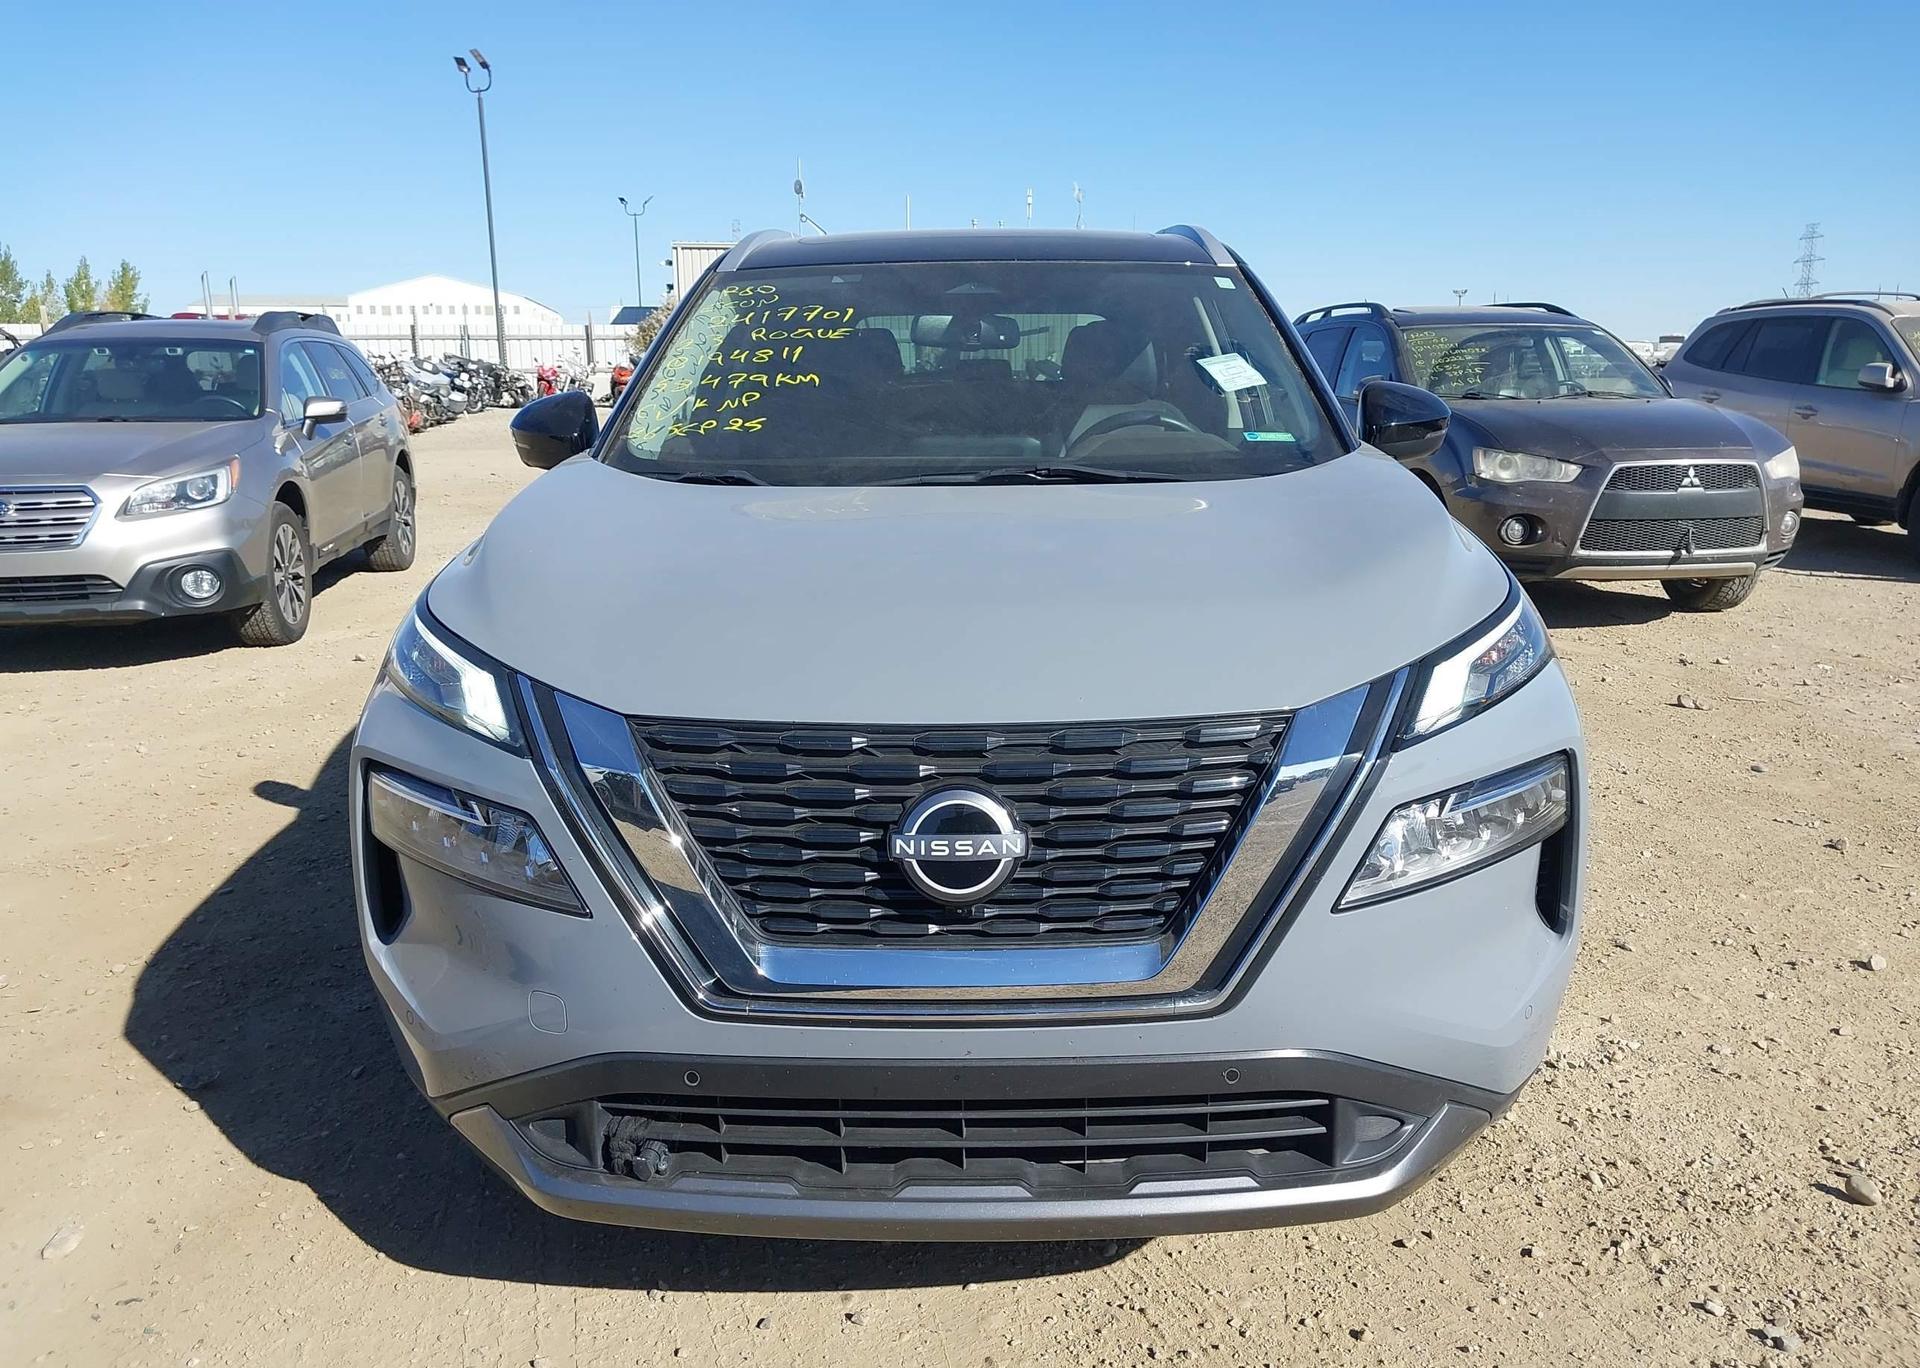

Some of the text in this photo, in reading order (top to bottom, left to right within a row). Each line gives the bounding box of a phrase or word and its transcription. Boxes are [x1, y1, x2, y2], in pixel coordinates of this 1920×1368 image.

[751, 327, 855, 342] ROGUE
[723, 417, 768, 433] 25
[894, 838, 1022, 857] NISSAN
